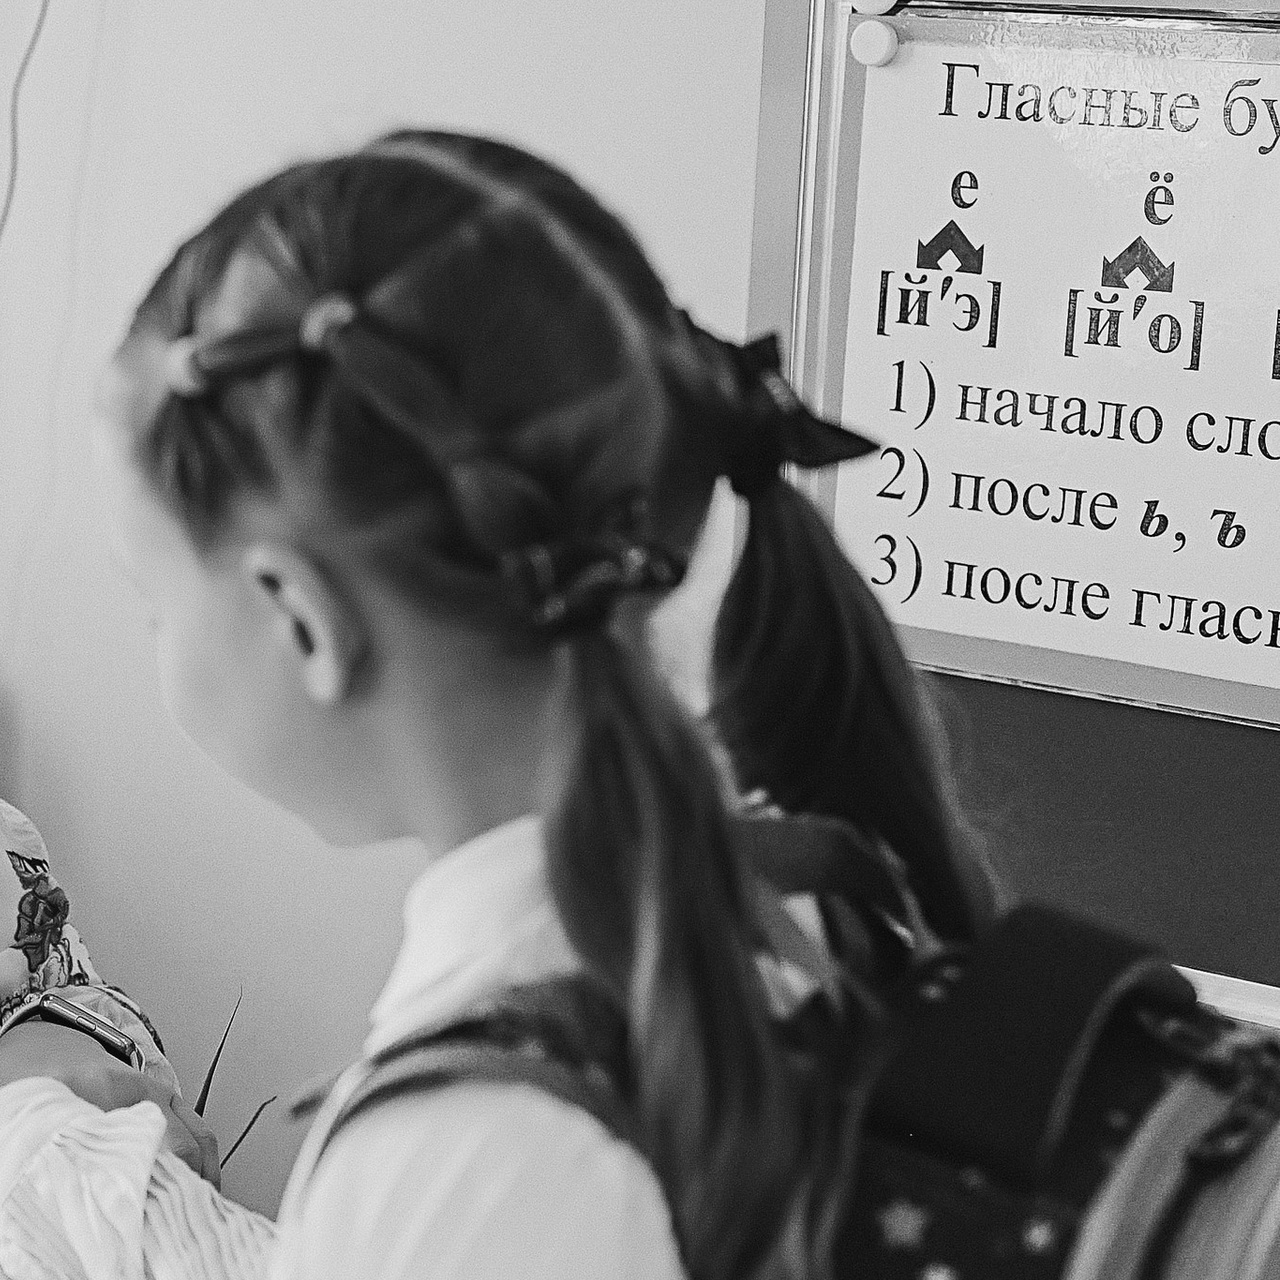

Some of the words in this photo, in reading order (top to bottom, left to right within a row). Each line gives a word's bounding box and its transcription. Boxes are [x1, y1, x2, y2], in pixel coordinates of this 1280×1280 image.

[938, 62, 1200, 133] Гласные
[951, 171, 979, 209] е
[1144, 172, 1175, 226] ё
[889, 359, 936, 430] 1)
[955, 384, 1164, 444] начало
[876, 447, 929, 518] 2)
[949, 472, 1119, 531] после
[870, 533, 922, 604] 3)
[941, 560, 1110, 621] после
